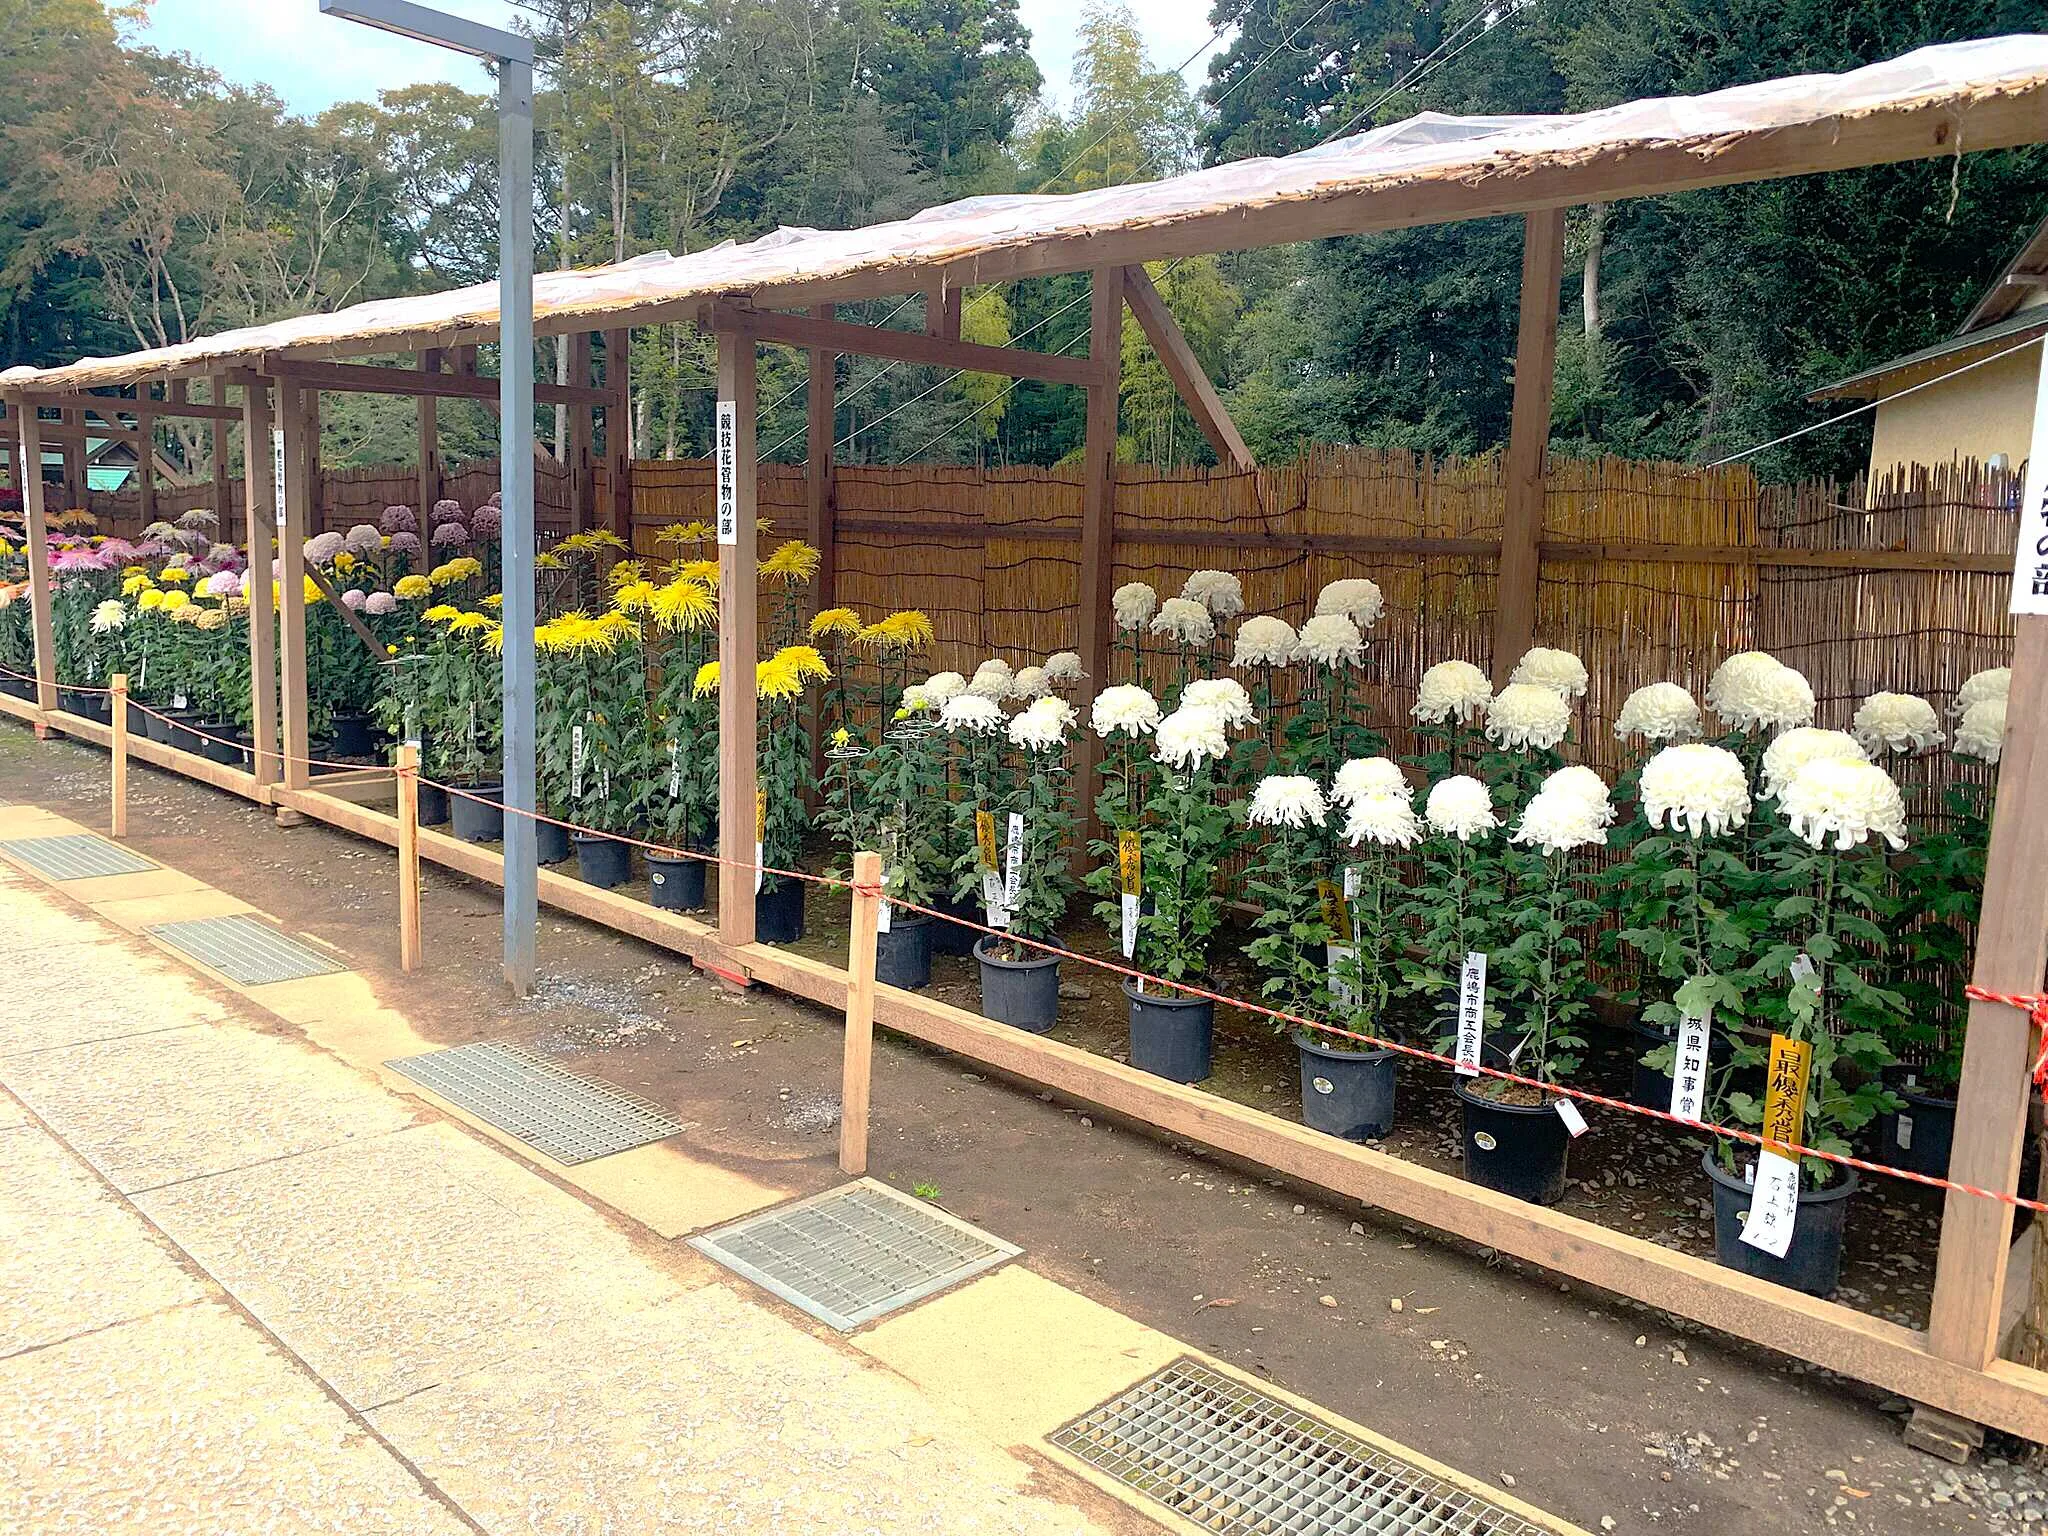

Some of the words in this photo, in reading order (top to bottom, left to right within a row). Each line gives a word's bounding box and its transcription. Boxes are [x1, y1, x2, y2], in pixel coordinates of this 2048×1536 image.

[720, 413, 732, 535] 競技花管物の部
[1679, 1016, 1704, 1115] 城県知事賞
[1768, 1049, 1802, 1156] 最優秀賞
